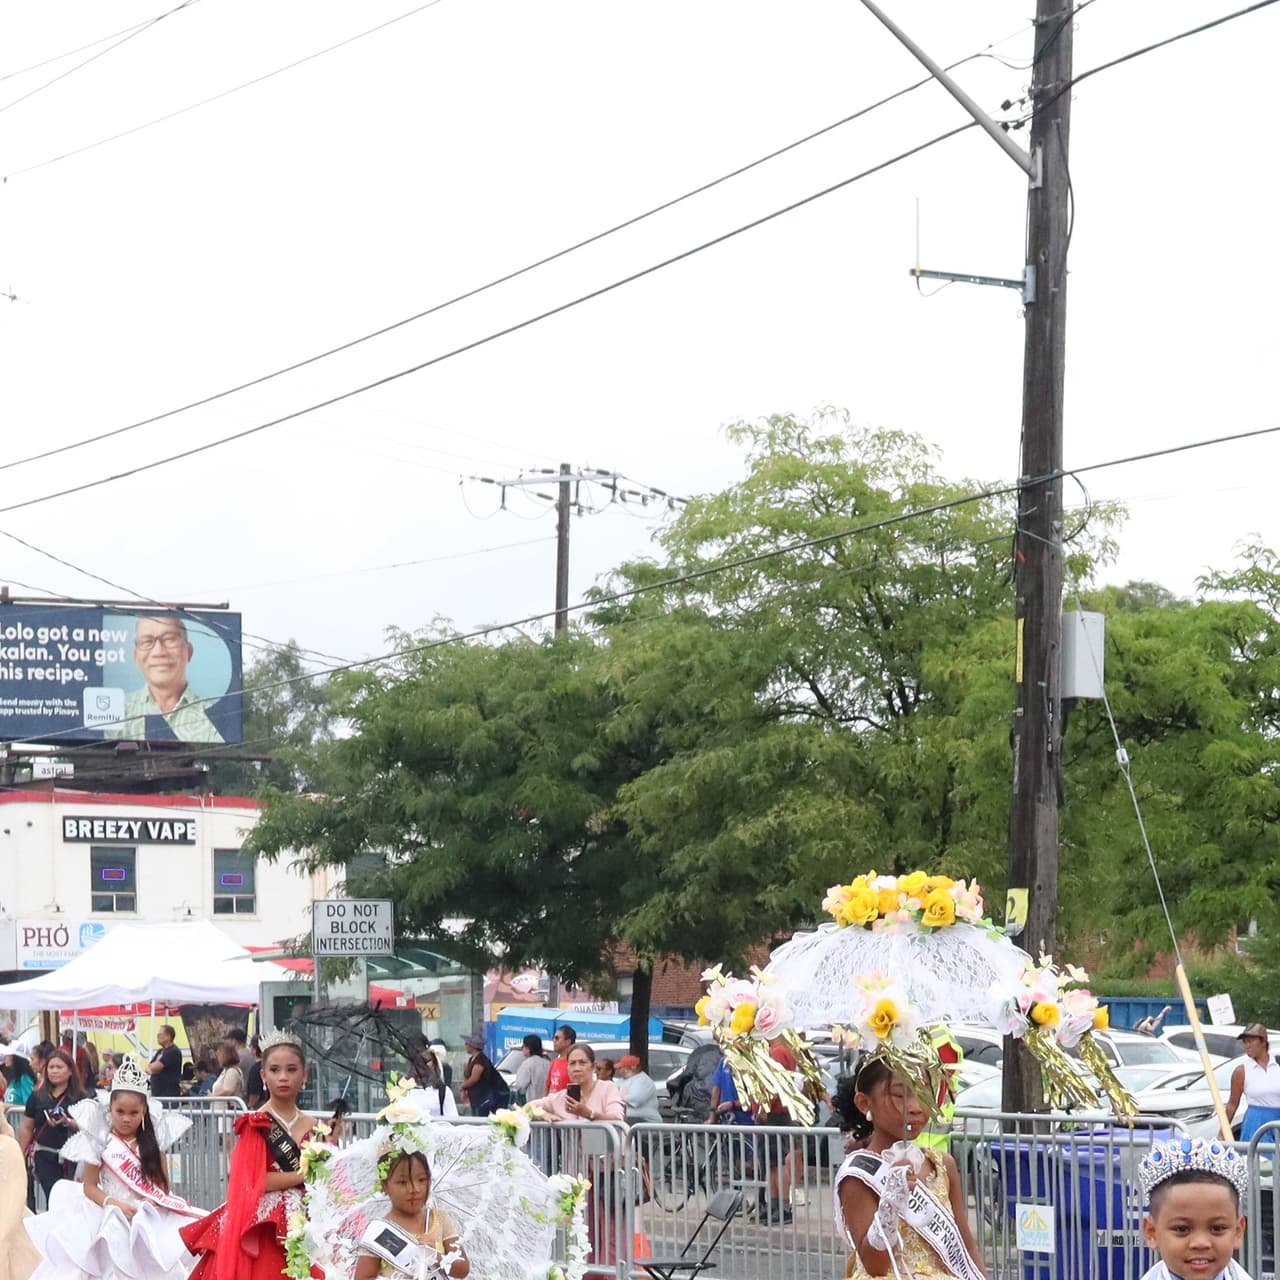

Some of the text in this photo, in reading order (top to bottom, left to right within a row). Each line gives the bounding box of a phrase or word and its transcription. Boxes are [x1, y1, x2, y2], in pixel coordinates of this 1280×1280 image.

[37, 625, 69, 643] got
[72, 628, 84, 642] a
[88, 629, 128, 643] new
[57, 643, 90, 661] You
[95, 647, 125, 666] got
[27, 663, 88, 684] recipe.
[19, 699, 43, 709] money
[44, 697, 63, 707] with
[65, 698, 77, 707] the
[15, 707, 42, 716] trusted
[43, 707, 52, 717] by
[54, 708, 80, 717] Pinoys
[65, 819, 196, 841] BREEZY VAPE
[327, 904, 379, 917] DO NOT
[330, 921, 376, 934] BLOCK
[316, 937, 390, 950] INTERSECTION
[908, 1198, 923, 1214] OF
[928, 1221, 942, 1236] HE
[941, 1234, 959, 1267] NIGHT
